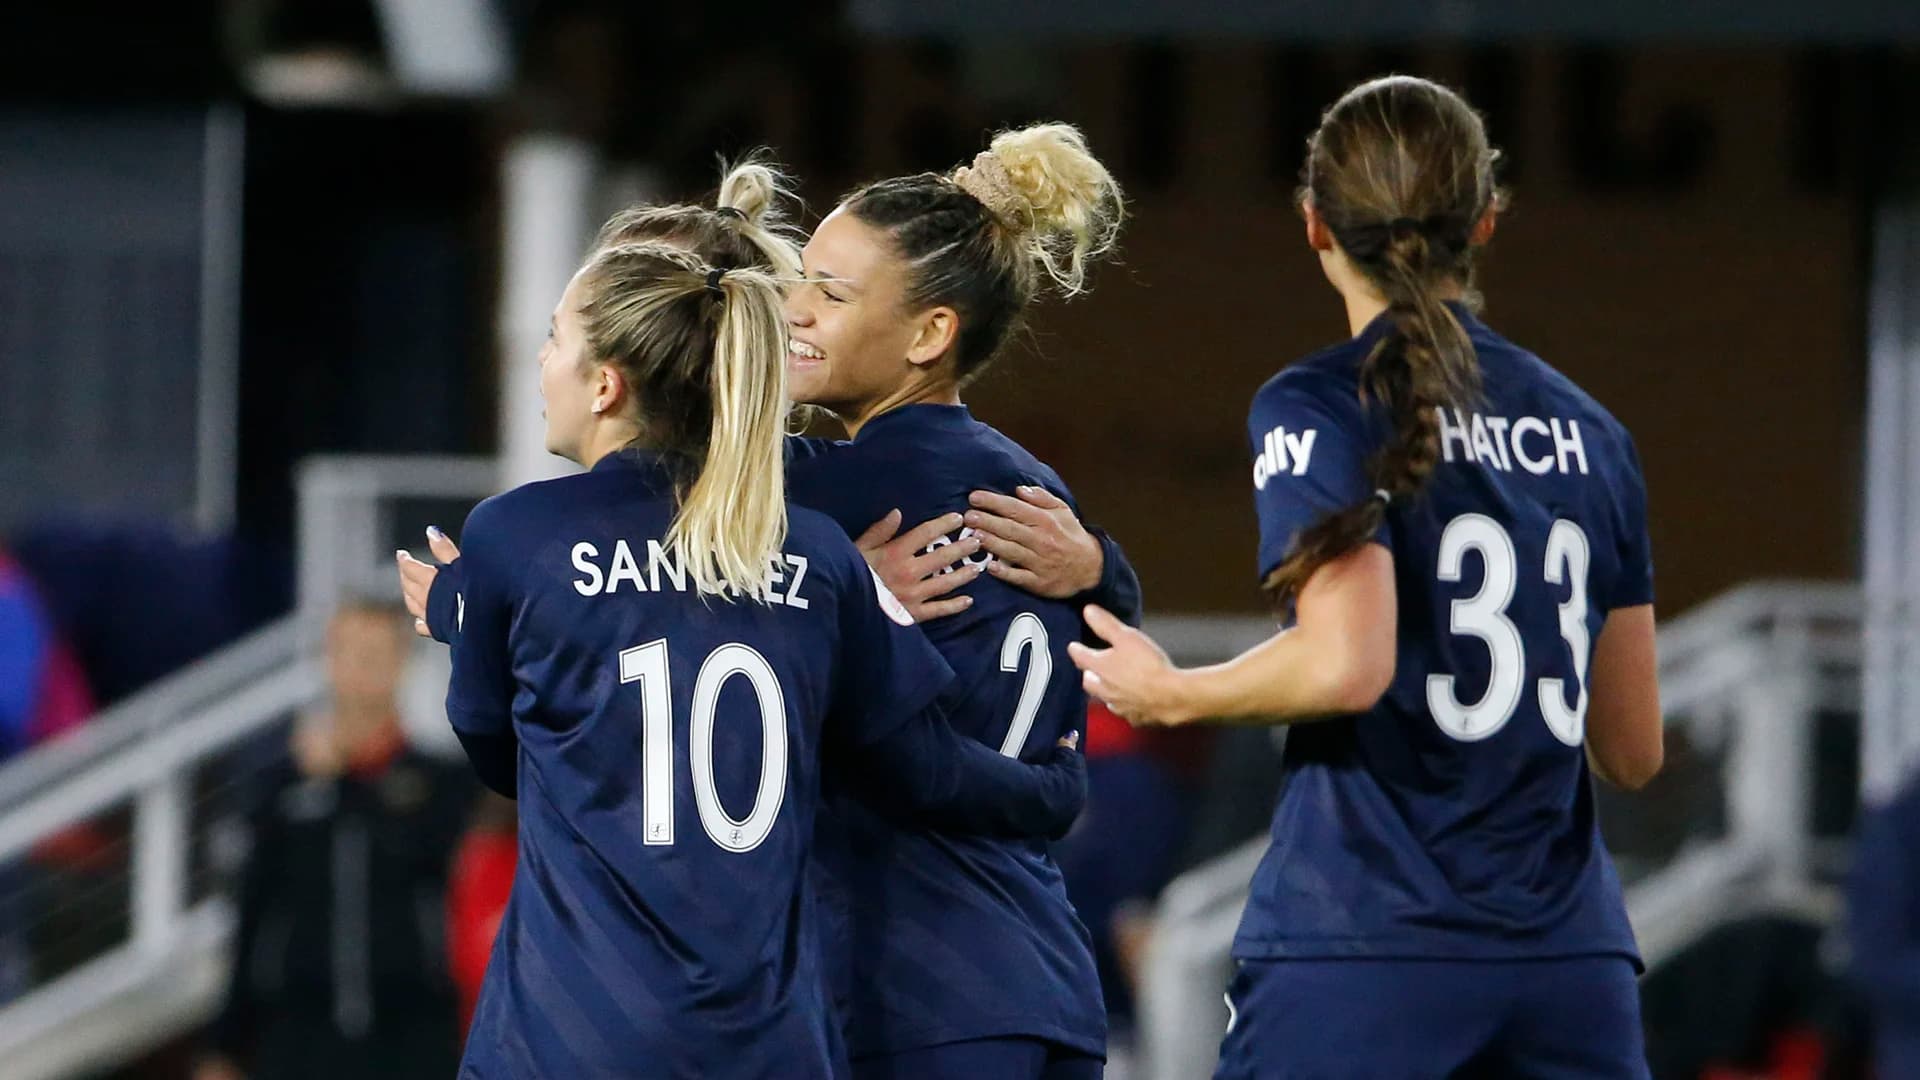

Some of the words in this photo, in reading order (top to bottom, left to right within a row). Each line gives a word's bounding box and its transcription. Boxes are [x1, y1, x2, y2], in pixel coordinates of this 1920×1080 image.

[1253, 425, 1317, 491] ally
[1435, 406, 1589, 475] HATCH
[571, 539, 810, 610] SANEZ
[1000, 611, 1053, 760] 2
[1426, 513, 1590, 748] 33
[619, 638, 788, 853] 10
